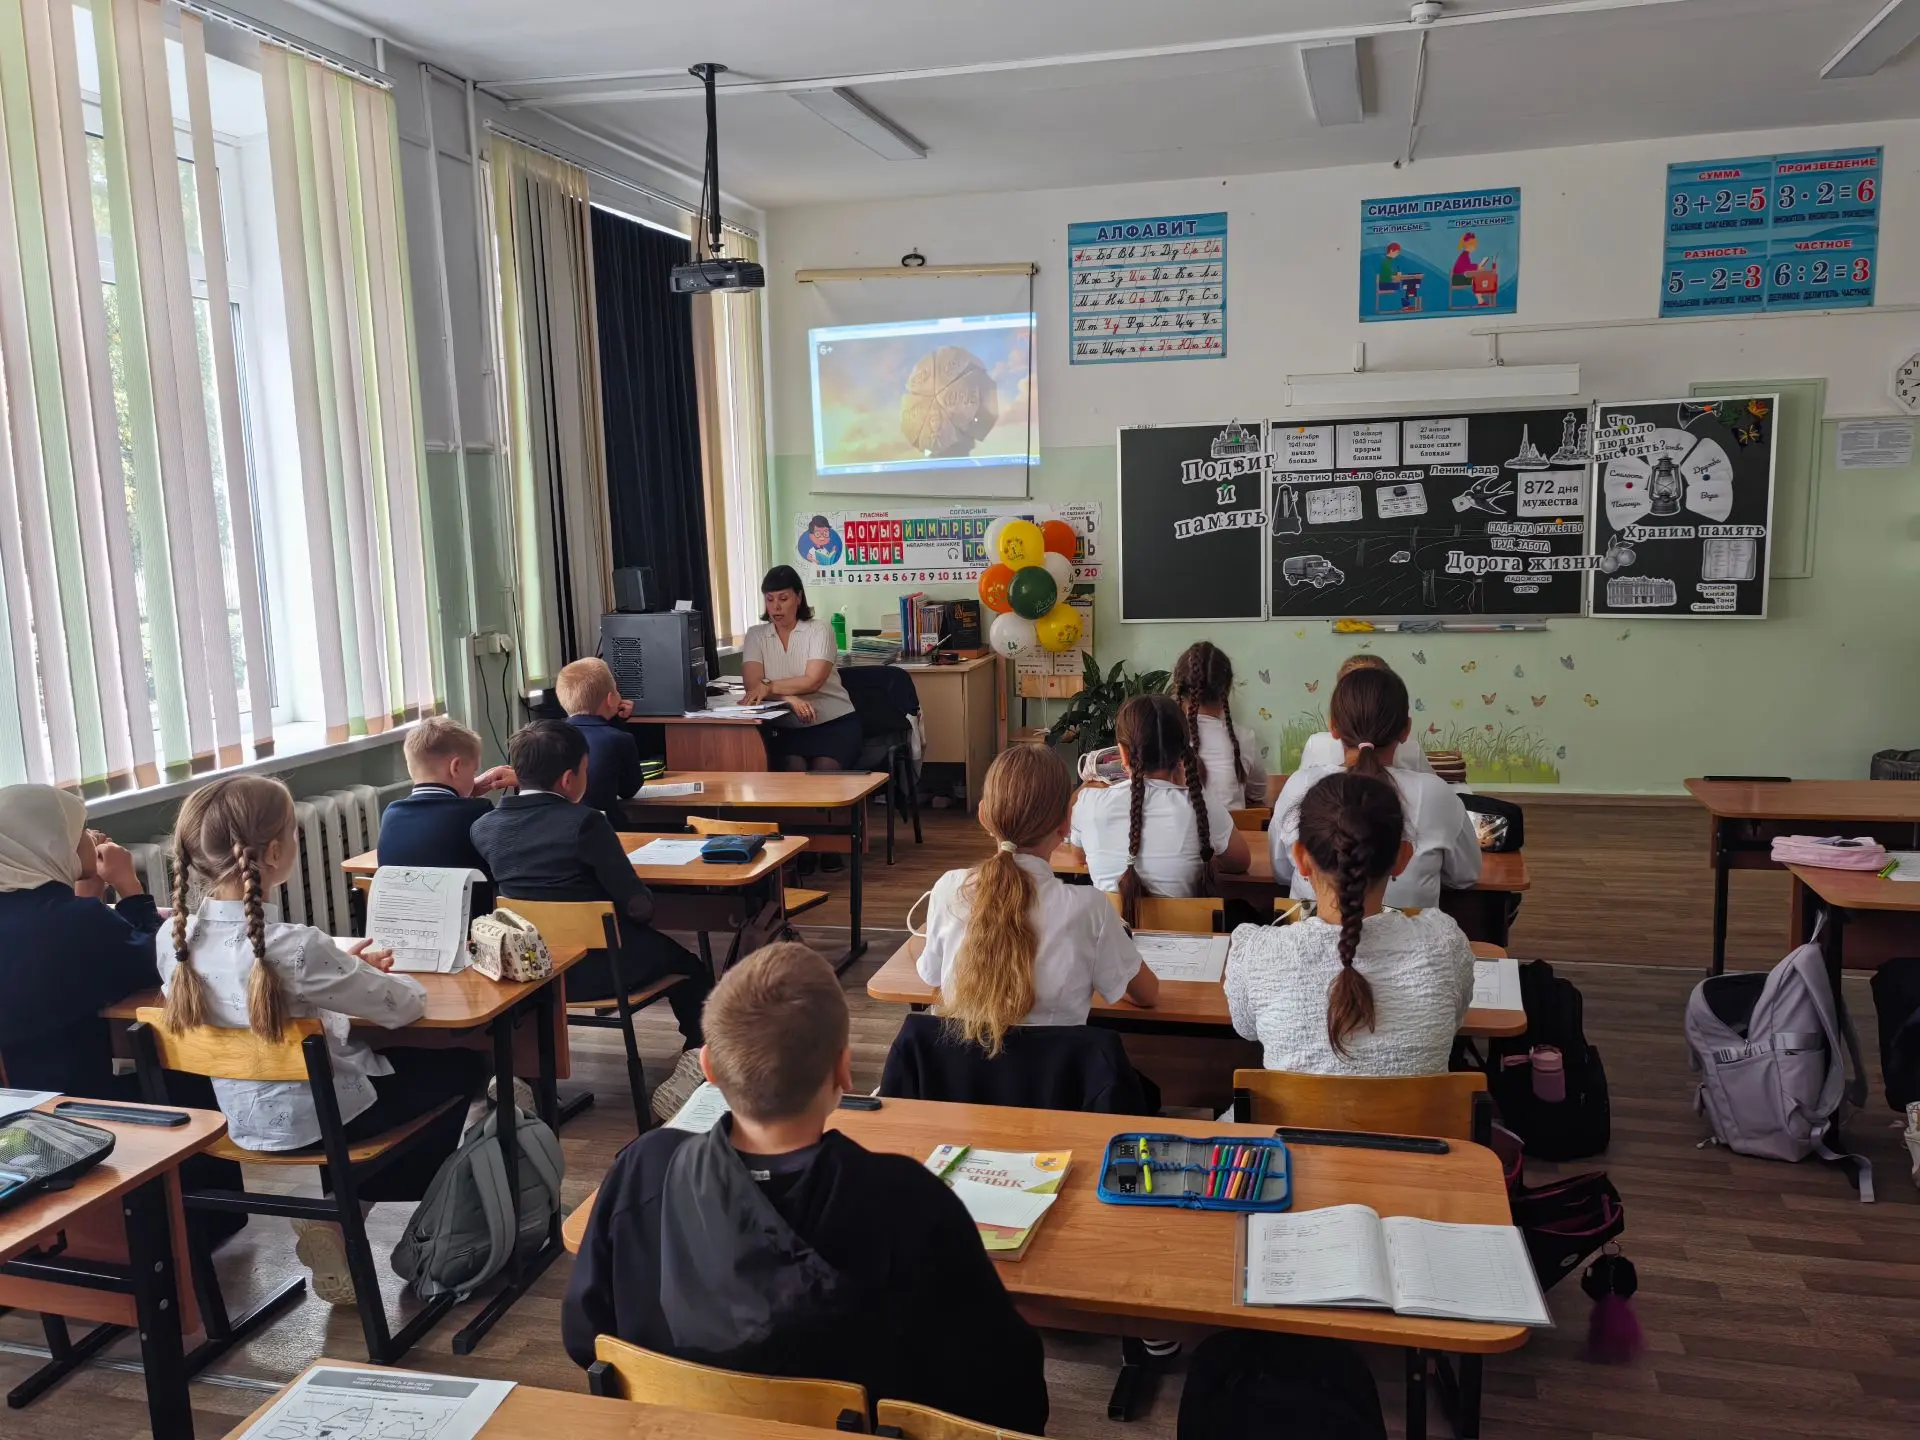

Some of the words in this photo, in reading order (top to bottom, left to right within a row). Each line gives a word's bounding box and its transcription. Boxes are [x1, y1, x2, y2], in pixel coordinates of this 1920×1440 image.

[1778, 158, 1878, 174] ПРОИЗВЕДЕНИЕ
[1698, 170, 1741, 180] СУММА
[1368, 203, 1419, 216] СИДИМ
[1423, 195, 1513, 211] ПРАВИЛЬНО
[1455, 219, 1472, 227] ПРИ
[1473, 217, 1507, 225] ЧТЕНИИ
[1097, 220, 1197, 241] АЛФАВИТ
[1795, 240, 1852, 251] ЧАСТНОЕ
[1685, 248, 1747, 259] РАЗНОСТЬ
[819, 346, 833, 355] 6+
[1609, 416, 1634, 427] Что
[1435, 433, 1449, 441] года
[1595, 424, 1654, 439] помогло
[1598, 435, 1645, 451] людям
[1183, 454, 1276, 482] Подвиг
[1335, 472, 1372, 480] начала
[1375, 470, 1423, 480] блокады
[1430, 466, 1498, 475] Ленинграда
[1524, 481, 1554, 494] 872
[1557, 486, 1578, 494] дня
[1219, 486, 1235, 503] и
[1522, 498, 1578, 508] мужества
[1176, 511, 1267, 538] память
[1489, 522, 1534, 535] НАДЕЖДА
[1536, 523, 1583, 534] МУЖЕСТВО
[1626, 526, 1693, 539] Храним
[1700, 526, 1764, 536] память
[1491, 539, 1514, 550] ТРУД
[1517, 541, 1550, 552] ЗАБОТА
[1447, 553, 1521, 573] Дорога
[1529, 557, 1602, 570] жизни
[857, 574, 862, 582] 1
[866, 574, 871, 582] 2
[883, 573, 889, 581] 4
[892, 573, 898, 581] 5
[902, 573, 907, 581] 6
[911, 573, 916, 581] 7
[929, 572, 934, 580] 9
[938, 572, 949, 580] 10
[952, 570, 962, 579] 11
[966, 570, 977, 579] 12
[1085, 568, 1097, 576] 20
[968, 1176, 1023, 1187] язык
